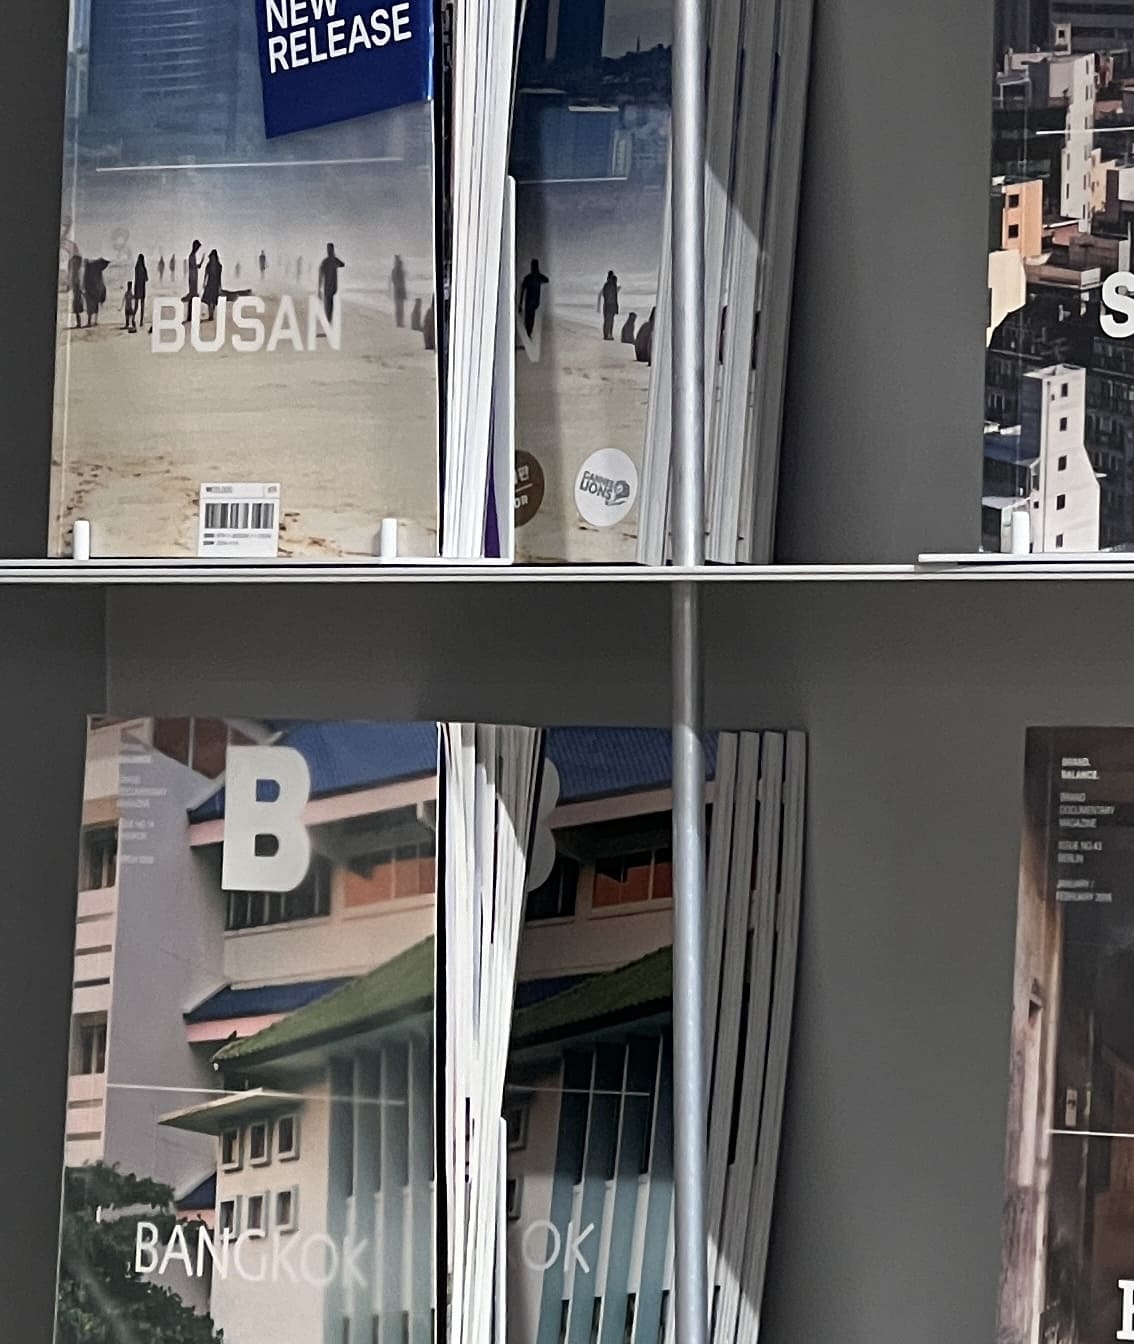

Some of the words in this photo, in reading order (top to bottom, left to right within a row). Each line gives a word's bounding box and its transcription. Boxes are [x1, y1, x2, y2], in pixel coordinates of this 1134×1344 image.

[268, 2, 412, 74] RELEASE
[151, 294, 342, 354] BUSAN
[222, 745, 311, 892] B
[134, 1220, 369, 1288] BANGKOK
